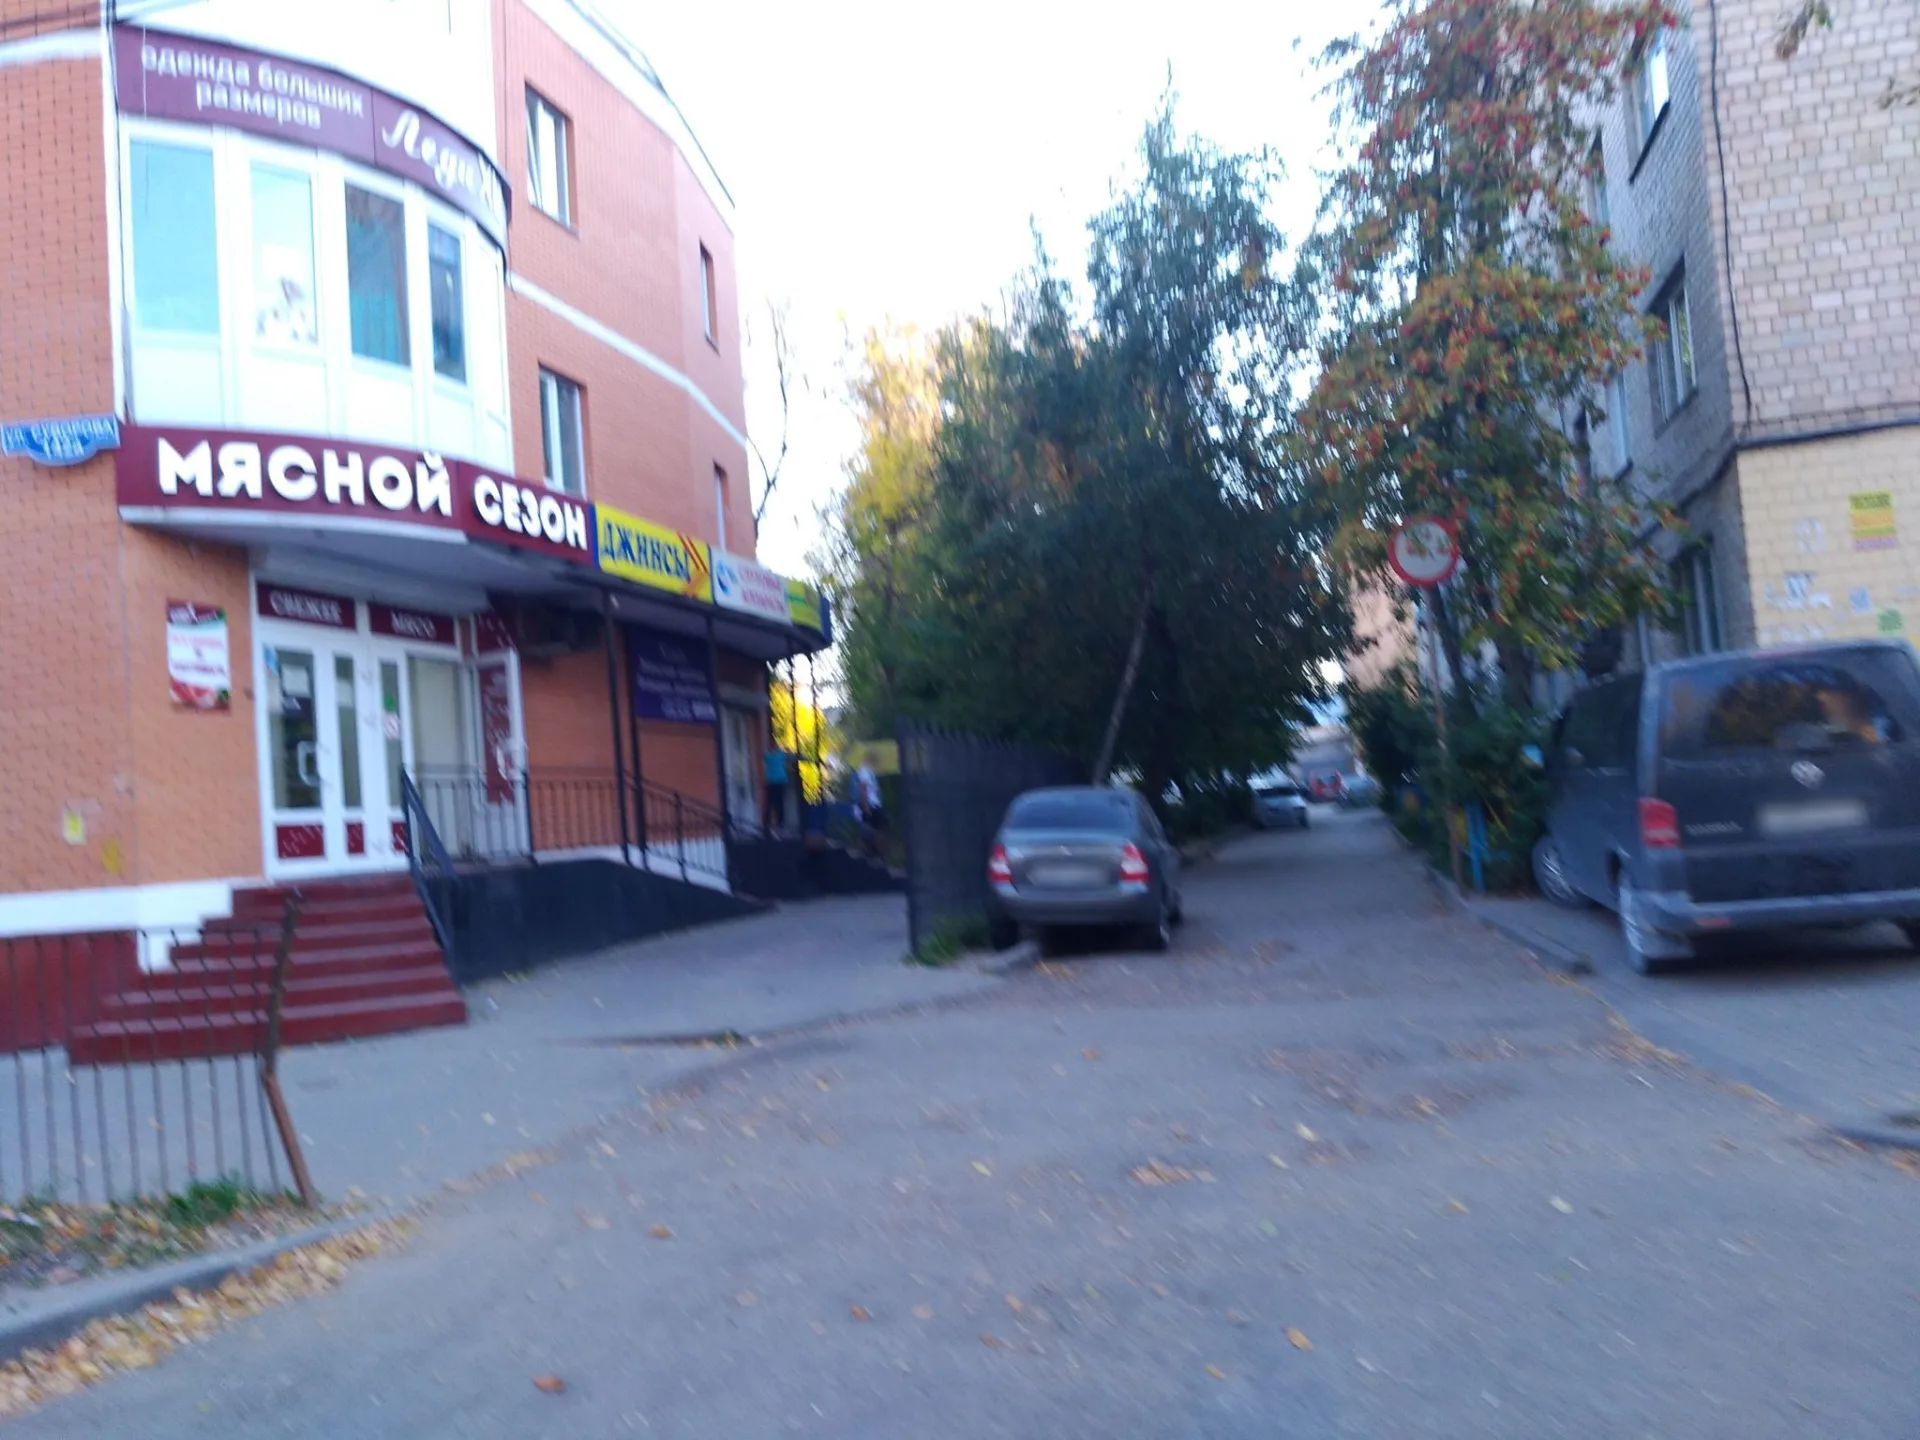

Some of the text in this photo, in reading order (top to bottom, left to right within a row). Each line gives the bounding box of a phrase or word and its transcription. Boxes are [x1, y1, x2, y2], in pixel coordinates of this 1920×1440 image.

[141, 45, 363, 119] одежда больших
[196, 80, 321, 129] размеров
[157, 437, 588, 551] МЯСНОЙ СЕЗОН
[602, 521, 691, 585] ДЖИНСЫ
